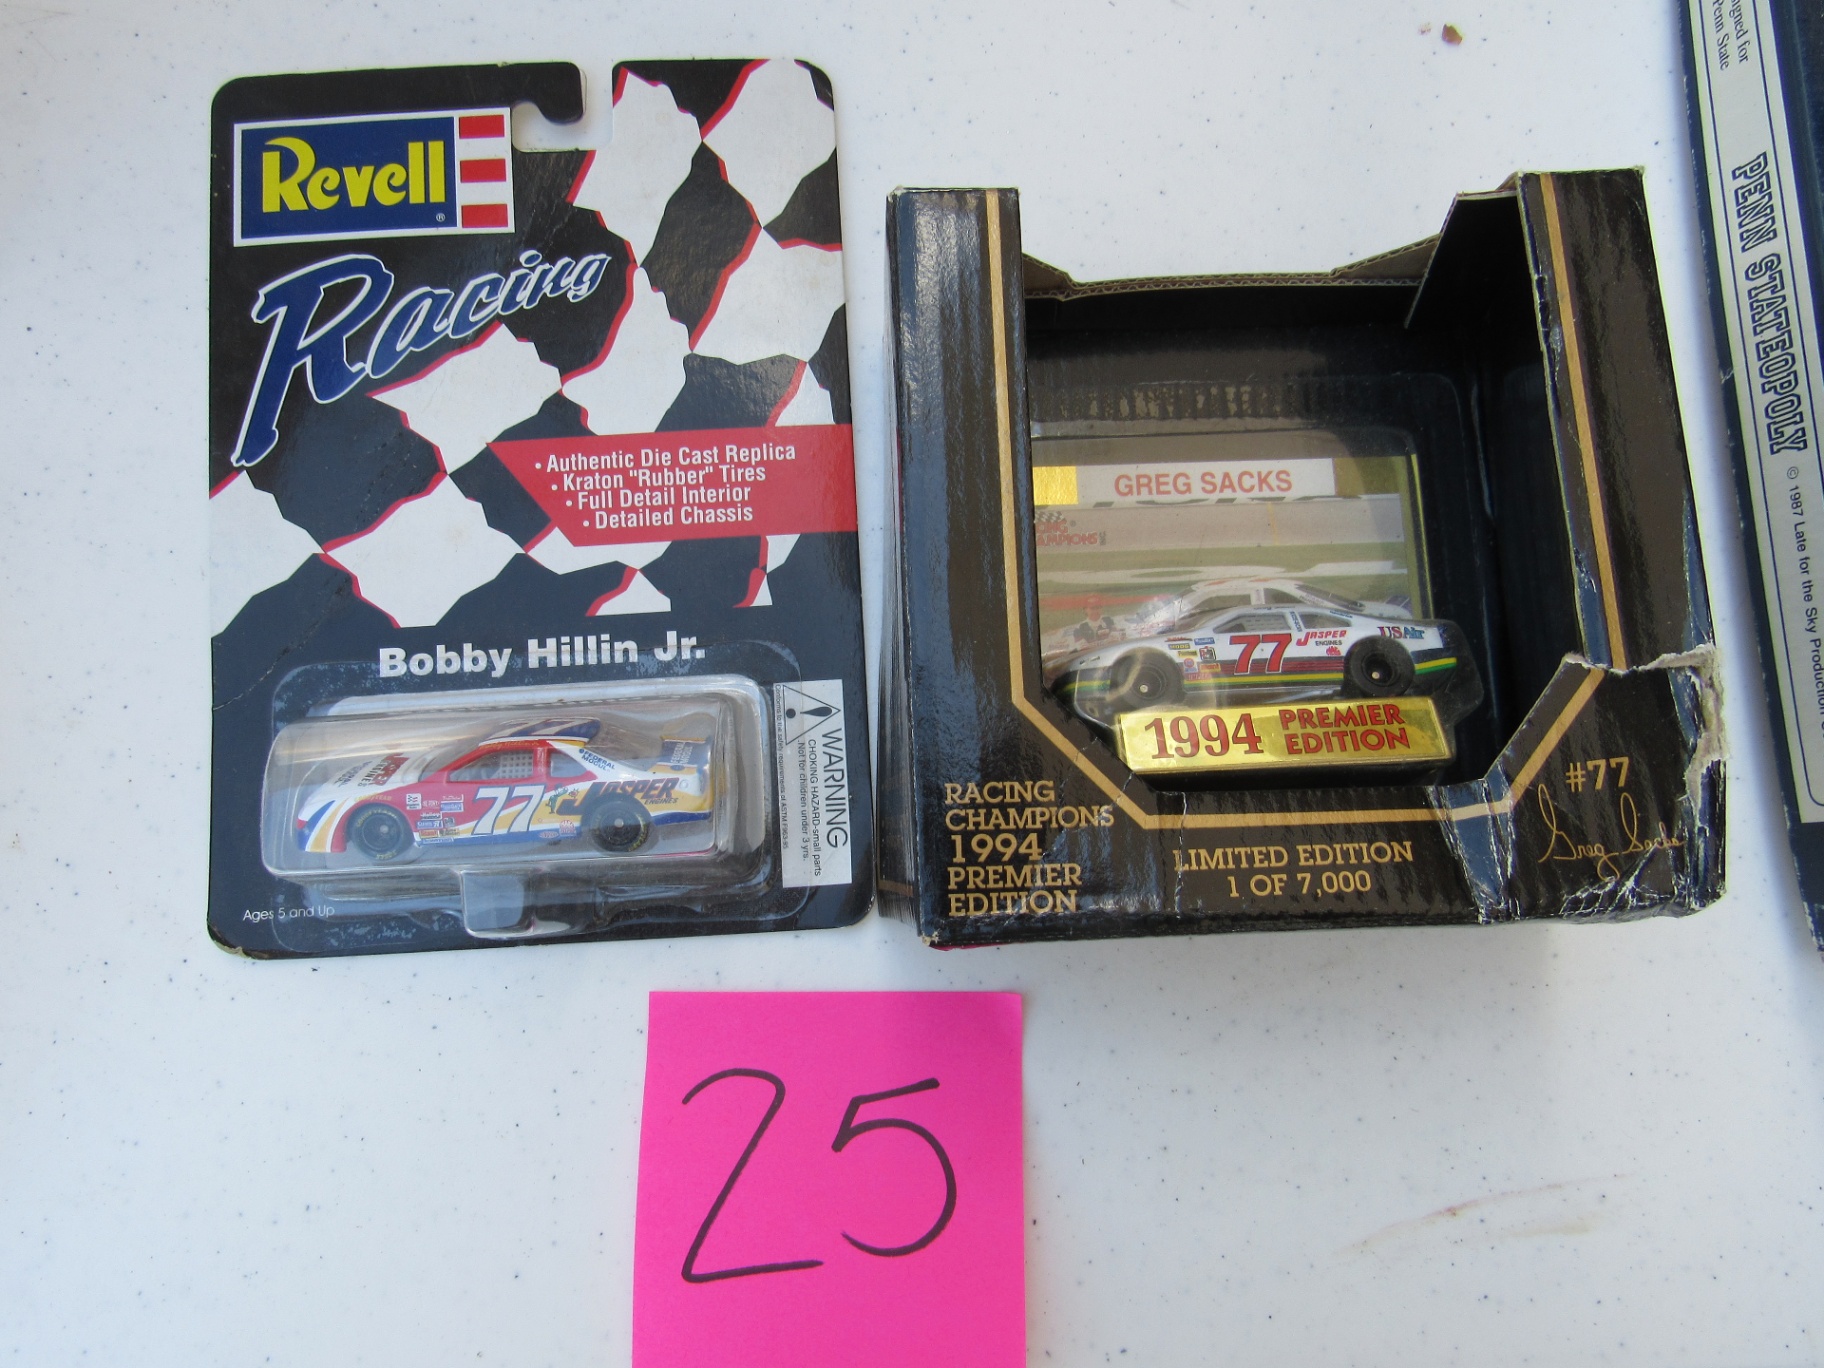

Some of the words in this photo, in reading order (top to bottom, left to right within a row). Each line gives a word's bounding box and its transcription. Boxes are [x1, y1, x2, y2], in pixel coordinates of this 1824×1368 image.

[1712, 0, 1724, 34] Penn
[1729, 0, 1748, 40] igned
[1717, 33, 1730, 70] State
[1738, 40, 1750, 64] for
[262, 137, 446, 213] Revell
[1732, 151, 1778, 254] PENN
[231, 251, 611, 468] Racing
[1745, 252, 1808, 456] STATEOPOLY
[547, 450, 635, 473] Authentic
[641, 447, 672, 468] Die
[678, 446, 719, 466] Cast
[725, 443, 796, 466] Replica
[563, 471, 624, 492] Kraton
[629, 466, 713, 488] "Rubber"
[719, 464, 766, 483] Tires
[1114, 472, 1192, 497] GREG
[1200, 470, 1293, 494] SACKS
[577, 490, 613, 510] Full
[620, 487, 675, 508] Detail
[682, 484, 751, 505] Interior
[1789, 485, 1804, 516] 1987
[595, 507, 674, 529] Detailed
[680, 503, 754, 525] Chassis
[1794, 521, 1807, 552] Late
[1799, 556, 1811, 575] for
[1802, 580, 1814, 602] the
[1805, 607, 1818, 633] Sky
[1296, 630, 1347, 647] JASPER
[379, 643, 513, 678] Bobby
[527, 633, 639, 669] Hillin
[653, 630, 706, 662] Jr.
[1228, 633, 1293, 676] 77
[1278, 703, 1406, 730] PREMIER
[777, 733, 785, 751] safety
[1144, 713, 1264, 760] 1994
[1284, 728, 1411, 755] EDITION
[581, 755, 607, 772] MOGUL
[583, 749, 617, 770] FEDERAL
[807, 739, 819, 783] CHOKING
[821, 727, 848, 848] WARNING
[1565, 757, 1630, 793] #77
[799, 773, 808, 807] children
[944, 780, 1056, 804] RACING
[471, 783, 546, 836] 77
[801, 810, 809, 834] under
[945, 804, 1115, 832] CHAMPIONS
[801, 845, 809, 861] yrs.
[951, 832, 1043, 864] 1994
[1173, 846, 1288, 872] LIMITED
[1296, 841, 1414, 867] EDITION
[812, 854, 822, 876] parts
[947, 862, 1082, 890] PREMIER
[1227, 876, 1239, 898] 1
[1250, 873, 1287, 897] OF
[1297, 870, 1372, 897] 7,000
[242, 908, 275, 923] Ages
[278, 907, 286, 919] 5
[289, 905, 315, 918] and
[317, 904, 335, 919] Up
[948, 889, 1078, 917] EDITION
[681, 1068, 957, 1284] 25
